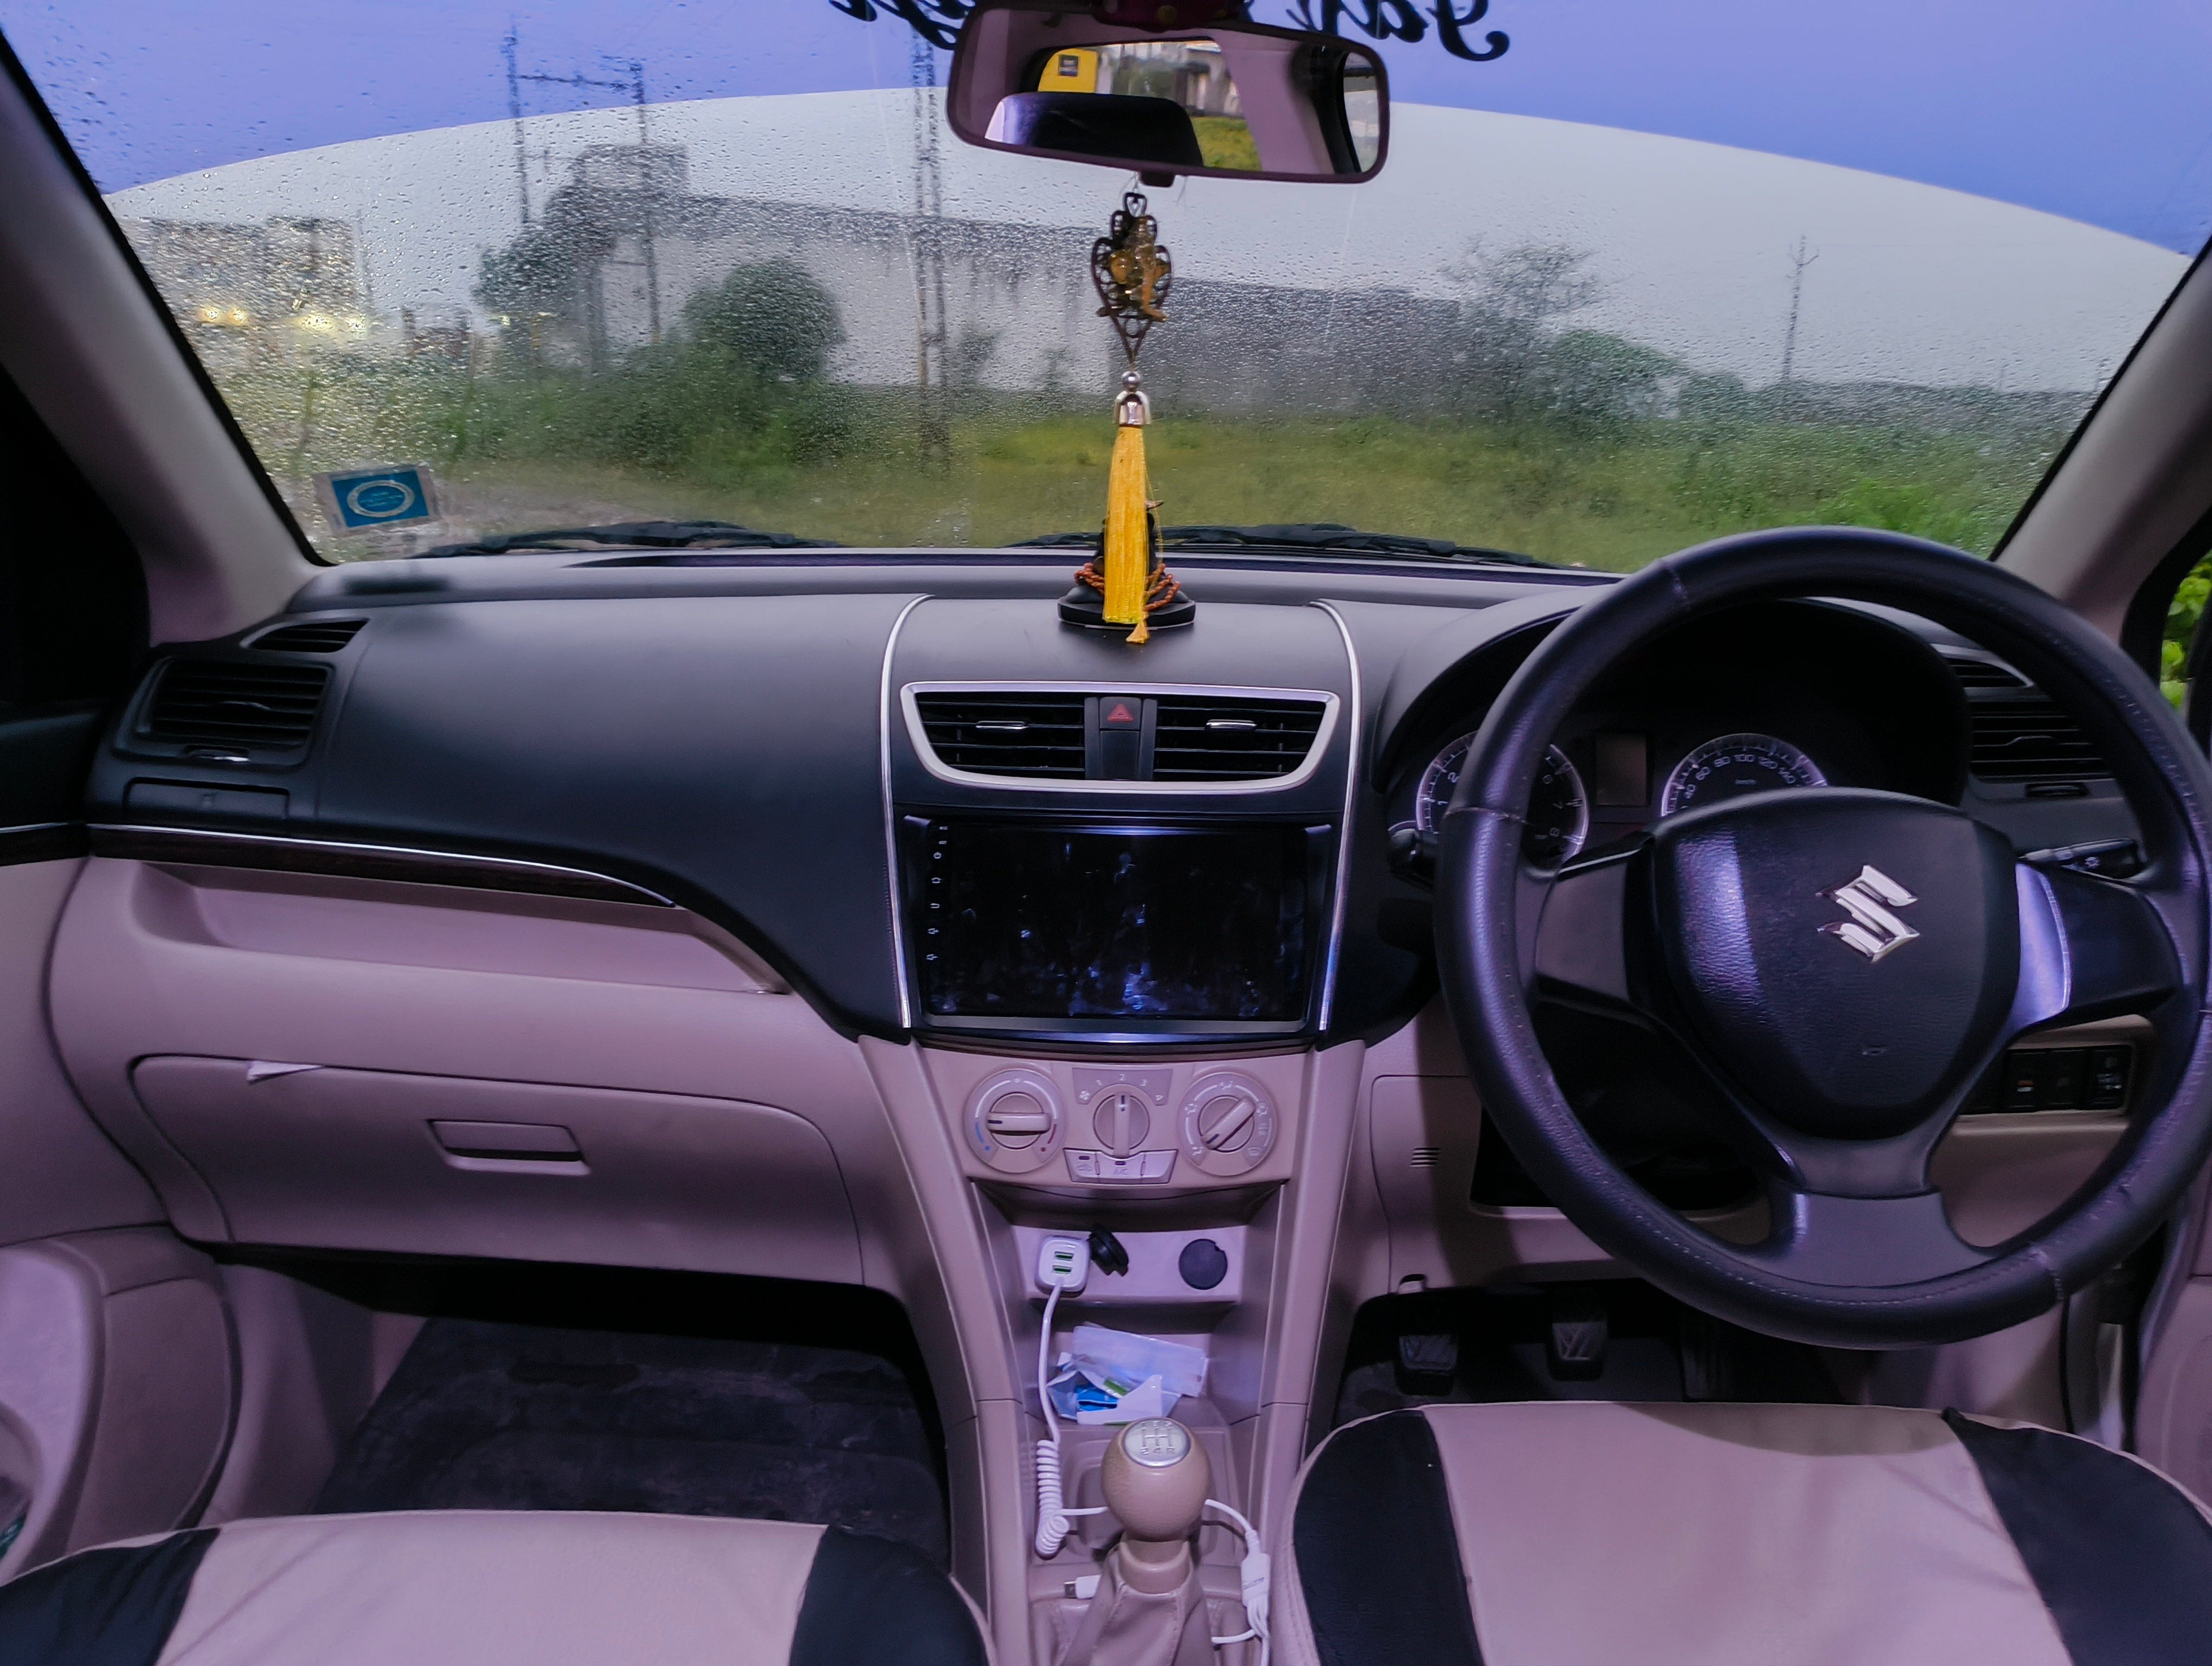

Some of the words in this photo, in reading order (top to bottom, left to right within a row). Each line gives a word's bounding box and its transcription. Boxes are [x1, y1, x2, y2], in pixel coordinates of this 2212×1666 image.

[1695, 766, 1711, 781] 60
[1714, 755, 1731, 768] 80
[1734, 753, 1755, 762] 100
[1758, 756, 1778, 770] 120
[1447, 771, 1460, 784] 2
[1140, 1446, 1149, 1455] 2
